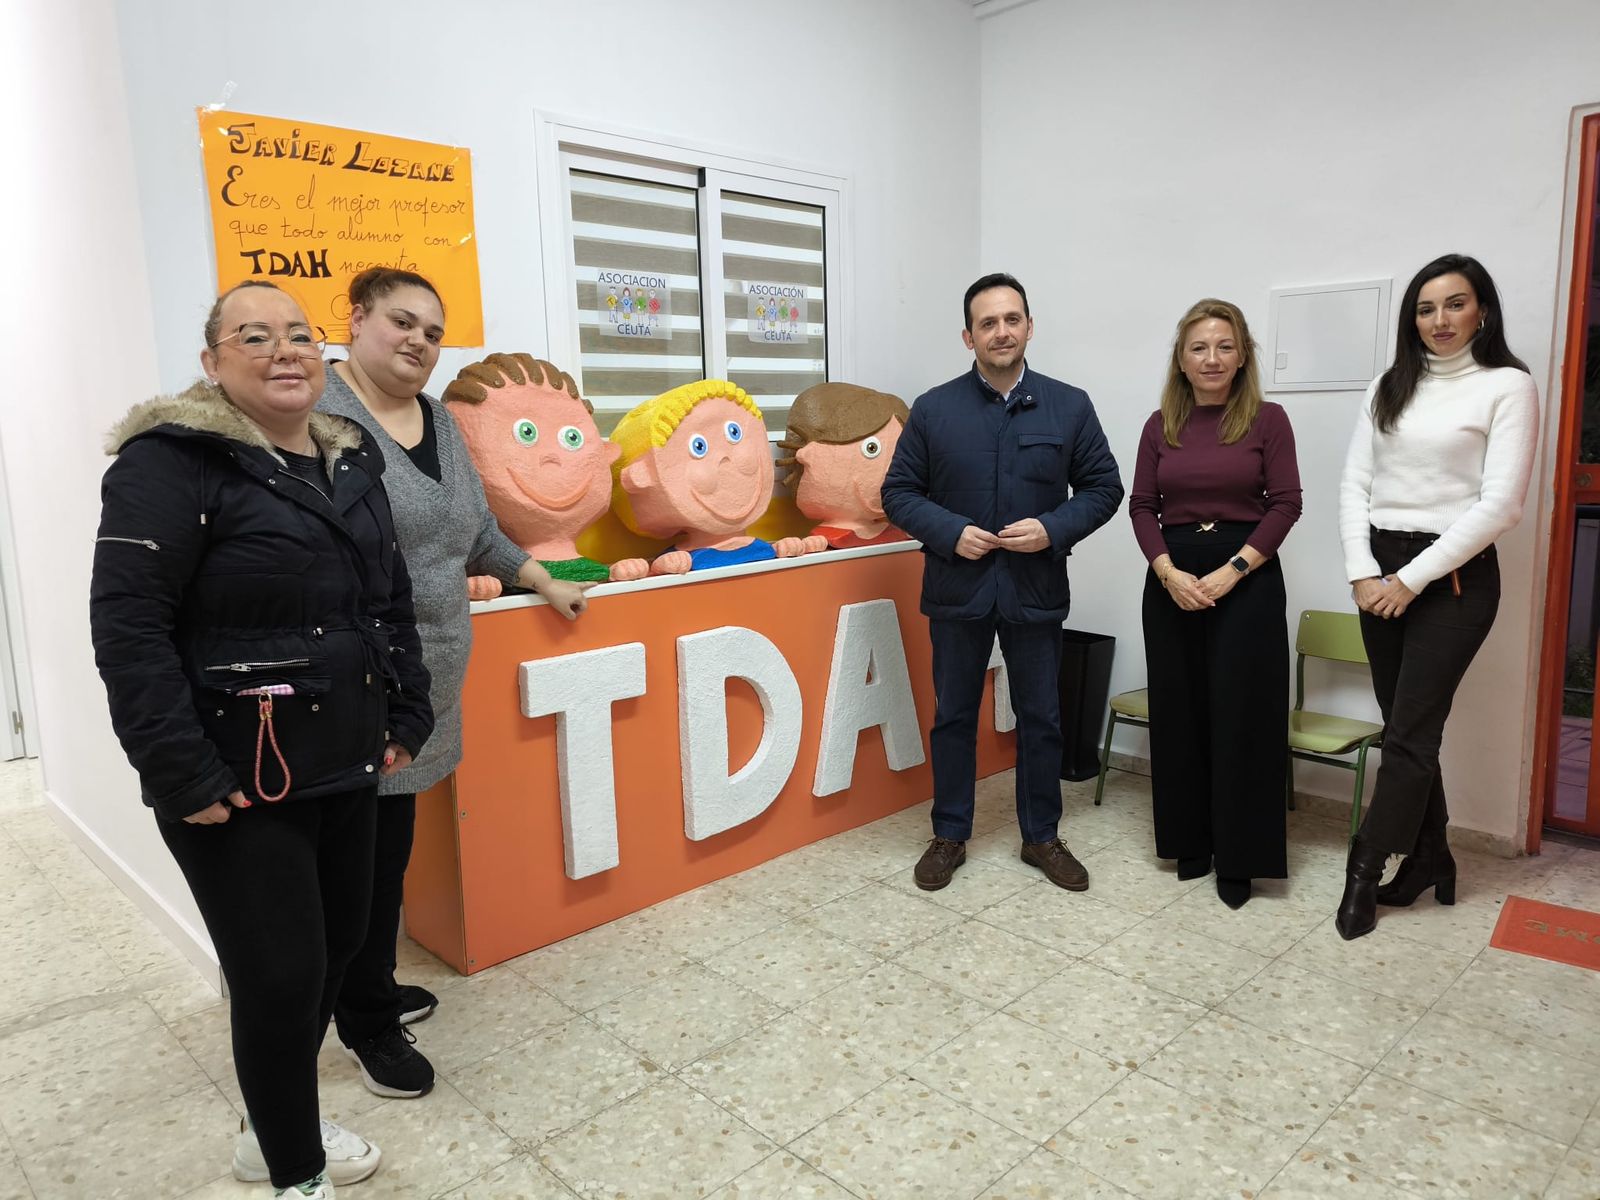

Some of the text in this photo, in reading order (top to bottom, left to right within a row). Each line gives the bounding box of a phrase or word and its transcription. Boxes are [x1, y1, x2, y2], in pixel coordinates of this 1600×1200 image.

[221, 165, 466, 228] Eres el mejor profesor
[229, 213, 452, 248] que todo alumno con
[240, 248, 332, 278] TDAH
[749, 285, 804, 298] ASOCIACIÓN
[617, 323, 652, 336] CEUTA
[764, 330, 793, 341] CEUTA
